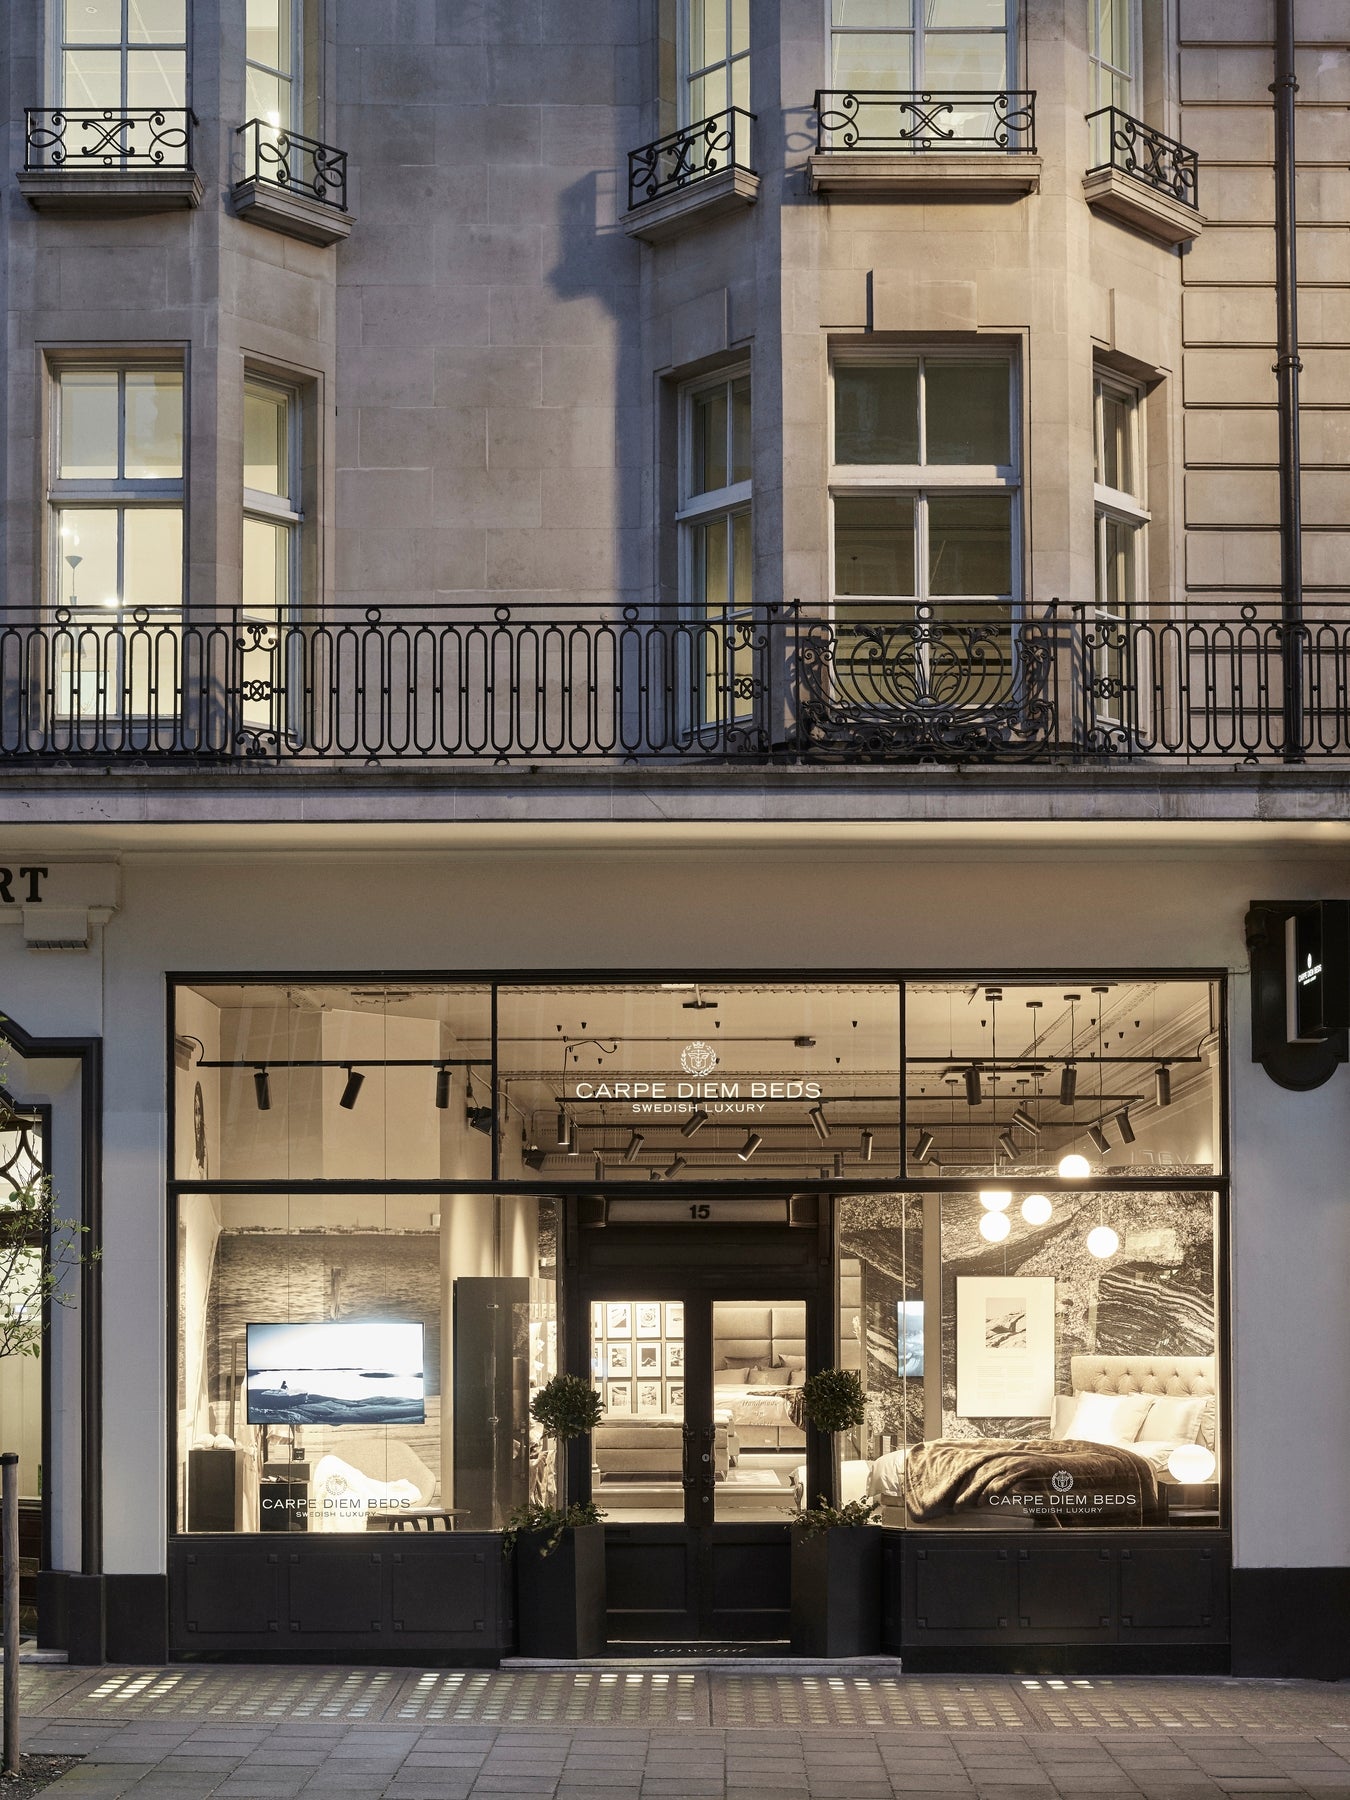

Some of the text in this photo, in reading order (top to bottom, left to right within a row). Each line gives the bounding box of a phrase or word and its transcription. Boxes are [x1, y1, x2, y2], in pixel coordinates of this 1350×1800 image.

[576, 1082, 821, 1099] CARPE DIEM BEDS
[632, 1103, 766, 1113] SWEDISH LUXURY
[689, 1204, 711, 1220] 15
[262, 1498, 411, 1510] CARPE DIEM BEDS
[989, 1494, 1136, 1506] CARPE DIEM BEDS
